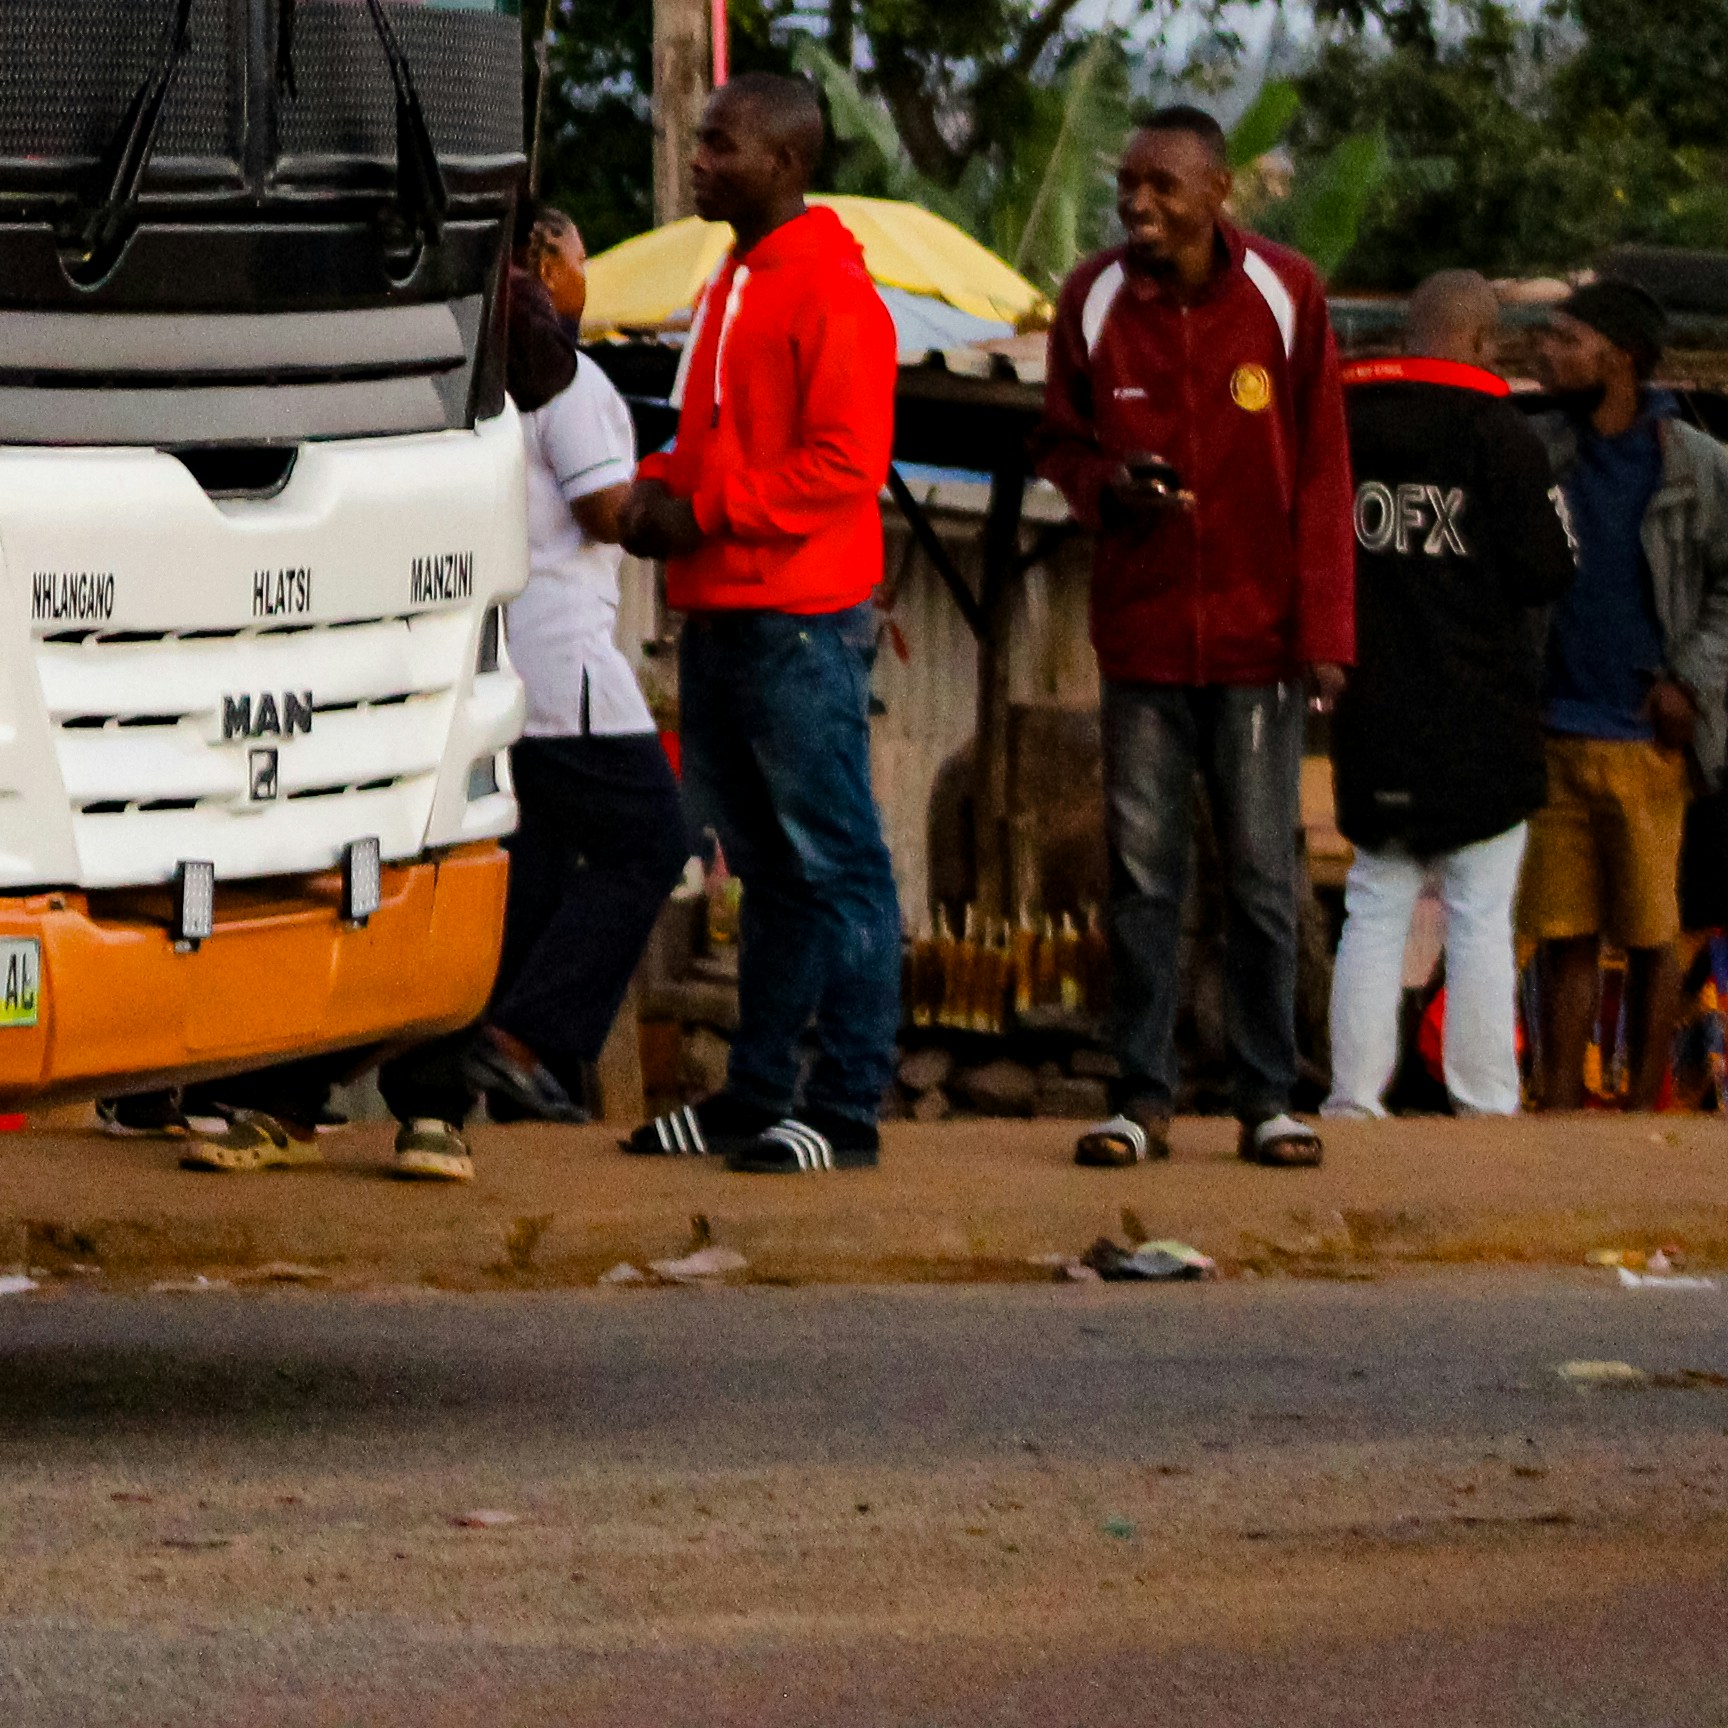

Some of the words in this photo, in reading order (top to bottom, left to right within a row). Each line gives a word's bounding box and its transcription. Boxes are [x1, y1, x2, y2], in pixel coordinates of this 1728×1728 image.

[31, 571, 115, 620] NHLANGANO
[252, 566, 311, 617] HLATSI
[410, 550, 473, 603] MANZINI
[222, 689, 313, 739] MAN
